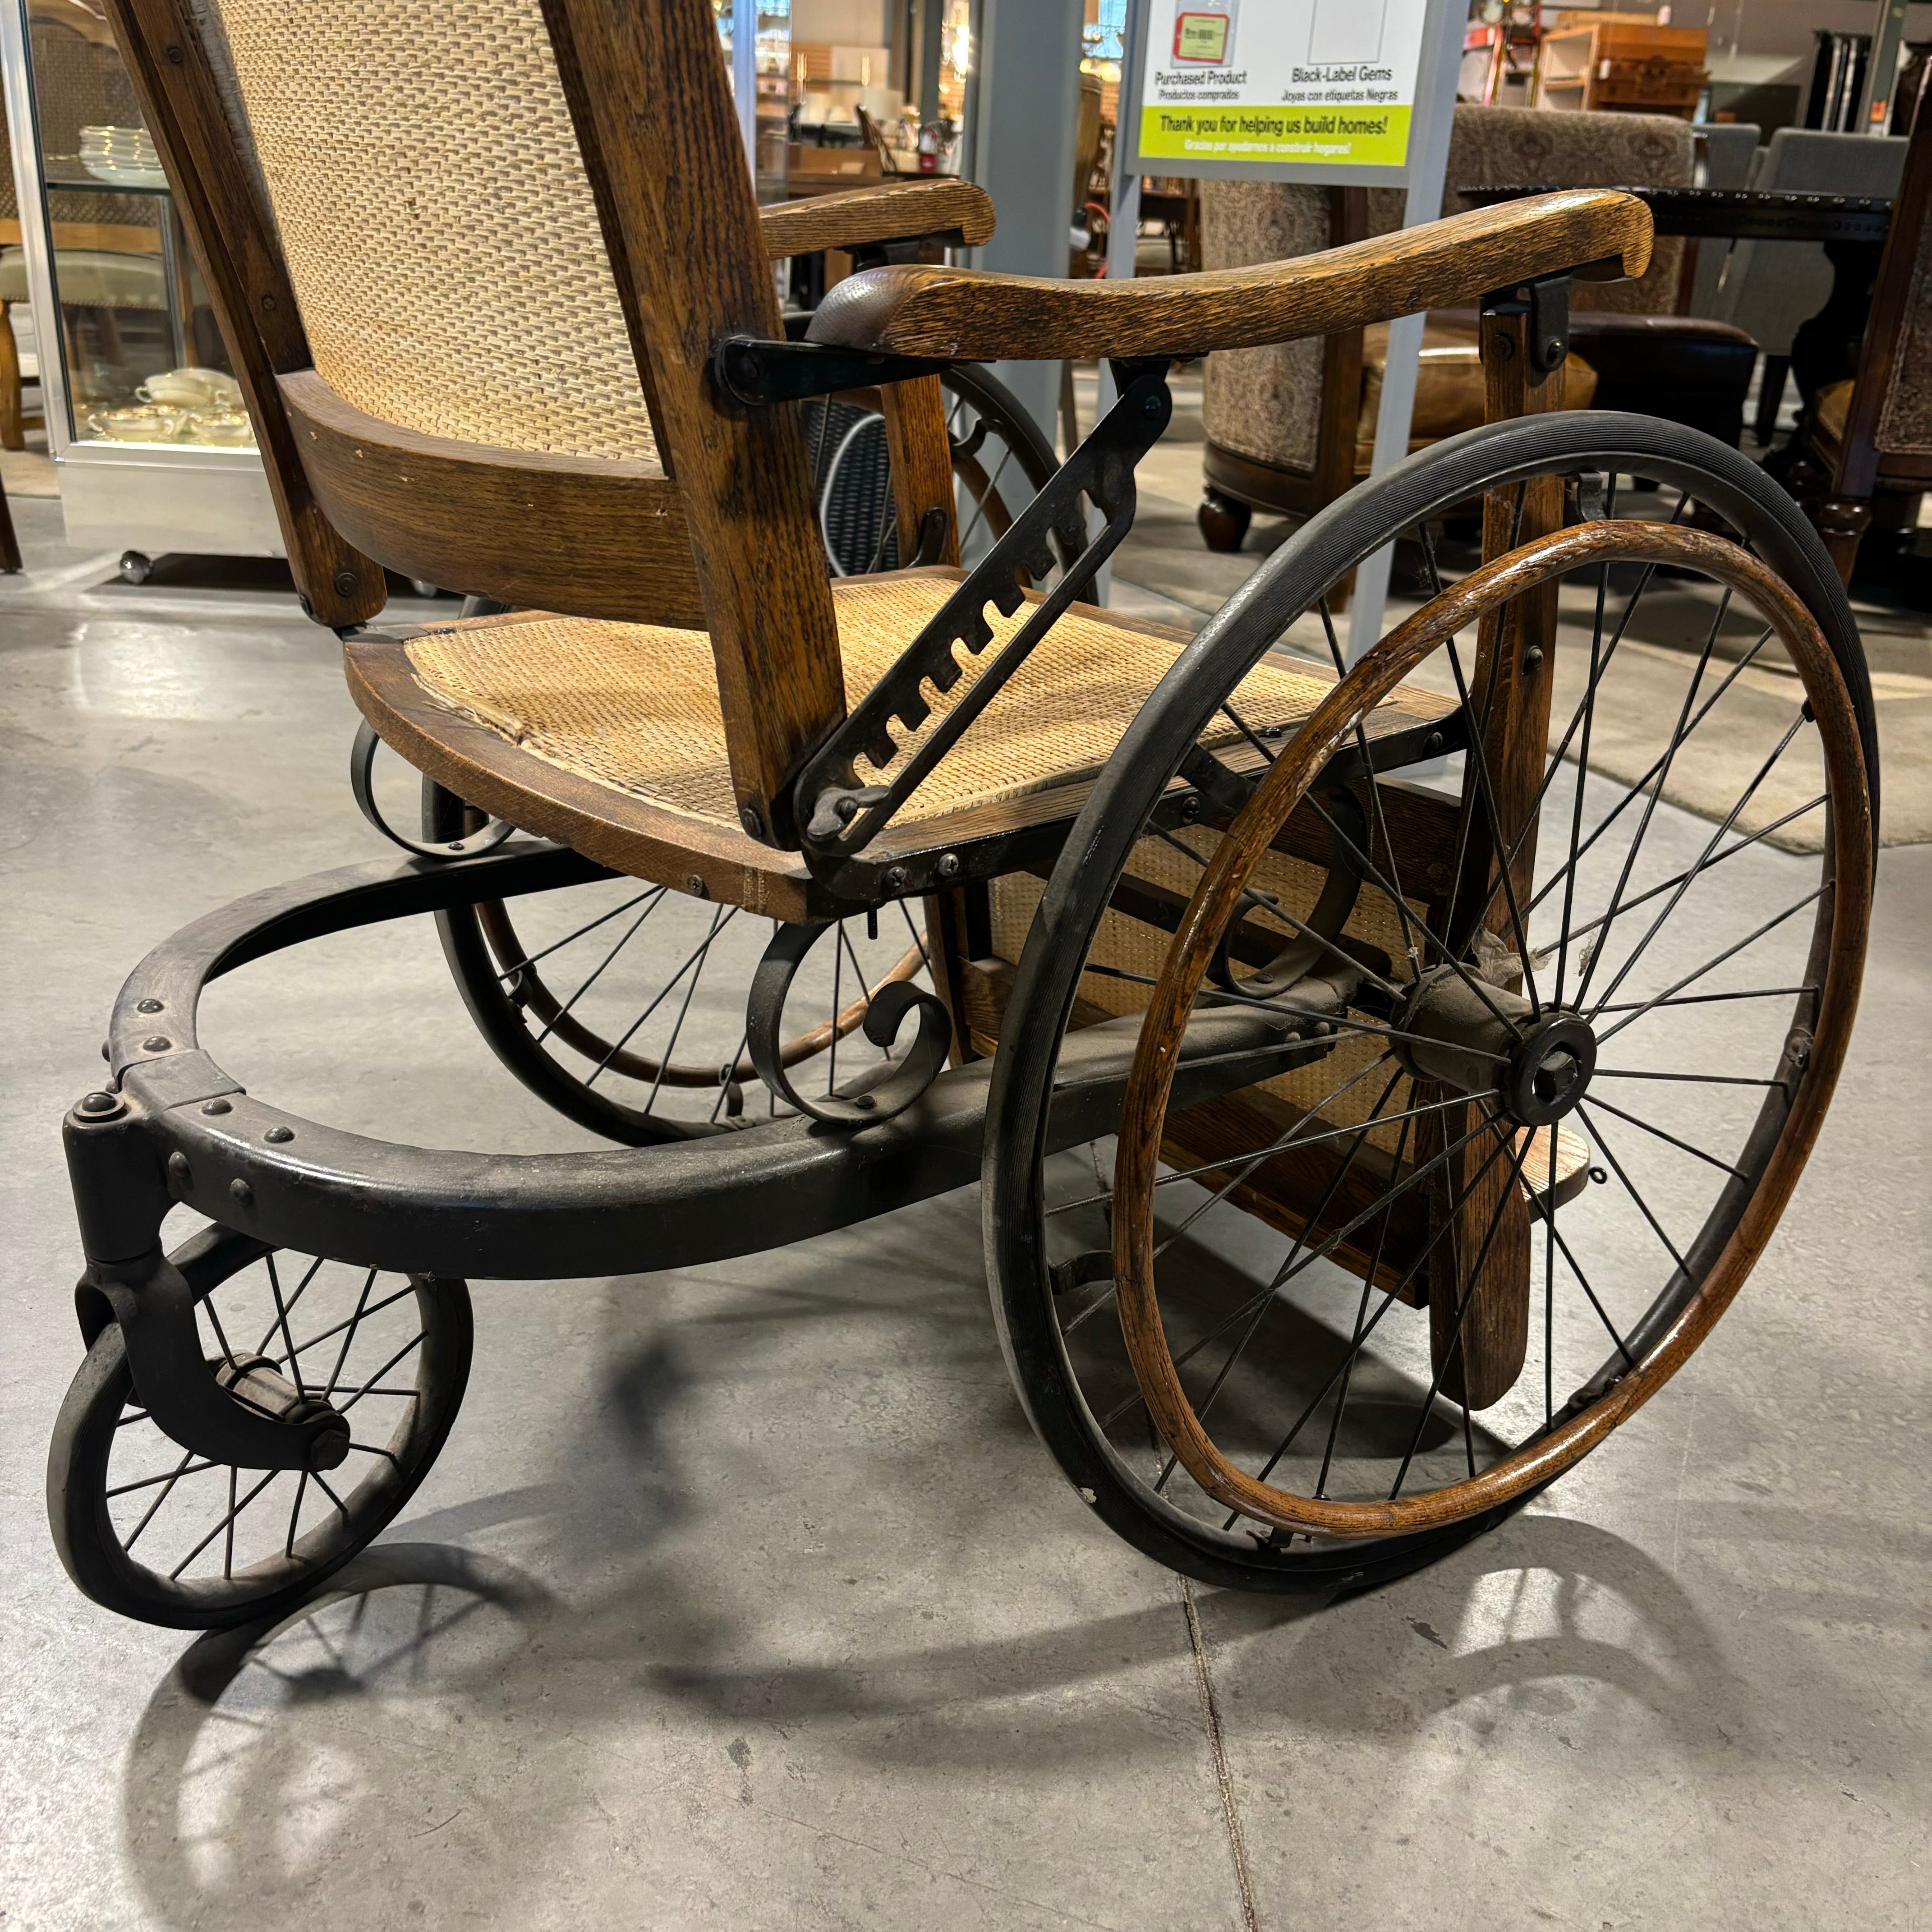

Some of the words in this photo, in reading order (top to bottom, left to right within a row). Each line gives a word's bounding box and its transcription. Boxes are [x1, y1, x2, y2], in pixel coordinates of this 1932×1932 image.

[1155, 71, 1205, 86] Purchased
[1208, 70, 1247, 85] Product
[1292, 67, 1357, 83] Black-Label
[1359, 66, 1393, 81] Gems
[1159, 89, 1196, 100] Productos
[1197, 90, 1239, 101] comprados
[1282, 89, 1305, 102] Joyas
[1308, 91, 1323, 101] con
[1325, 90, 1364, 102] etiquetas
[1366, 89, 1398, 102] Negras
[1160, 115, 1193, 132] Thank
[1196, 119, 1218, 135] you
[1220, 115, 1237, 132] for
[1239, 115, 1284, 137] helping
[1286, 120, 1301, 133] us
[1303, 115, 1336, 133] build
[1338, 116, 1389, 135] homes!
